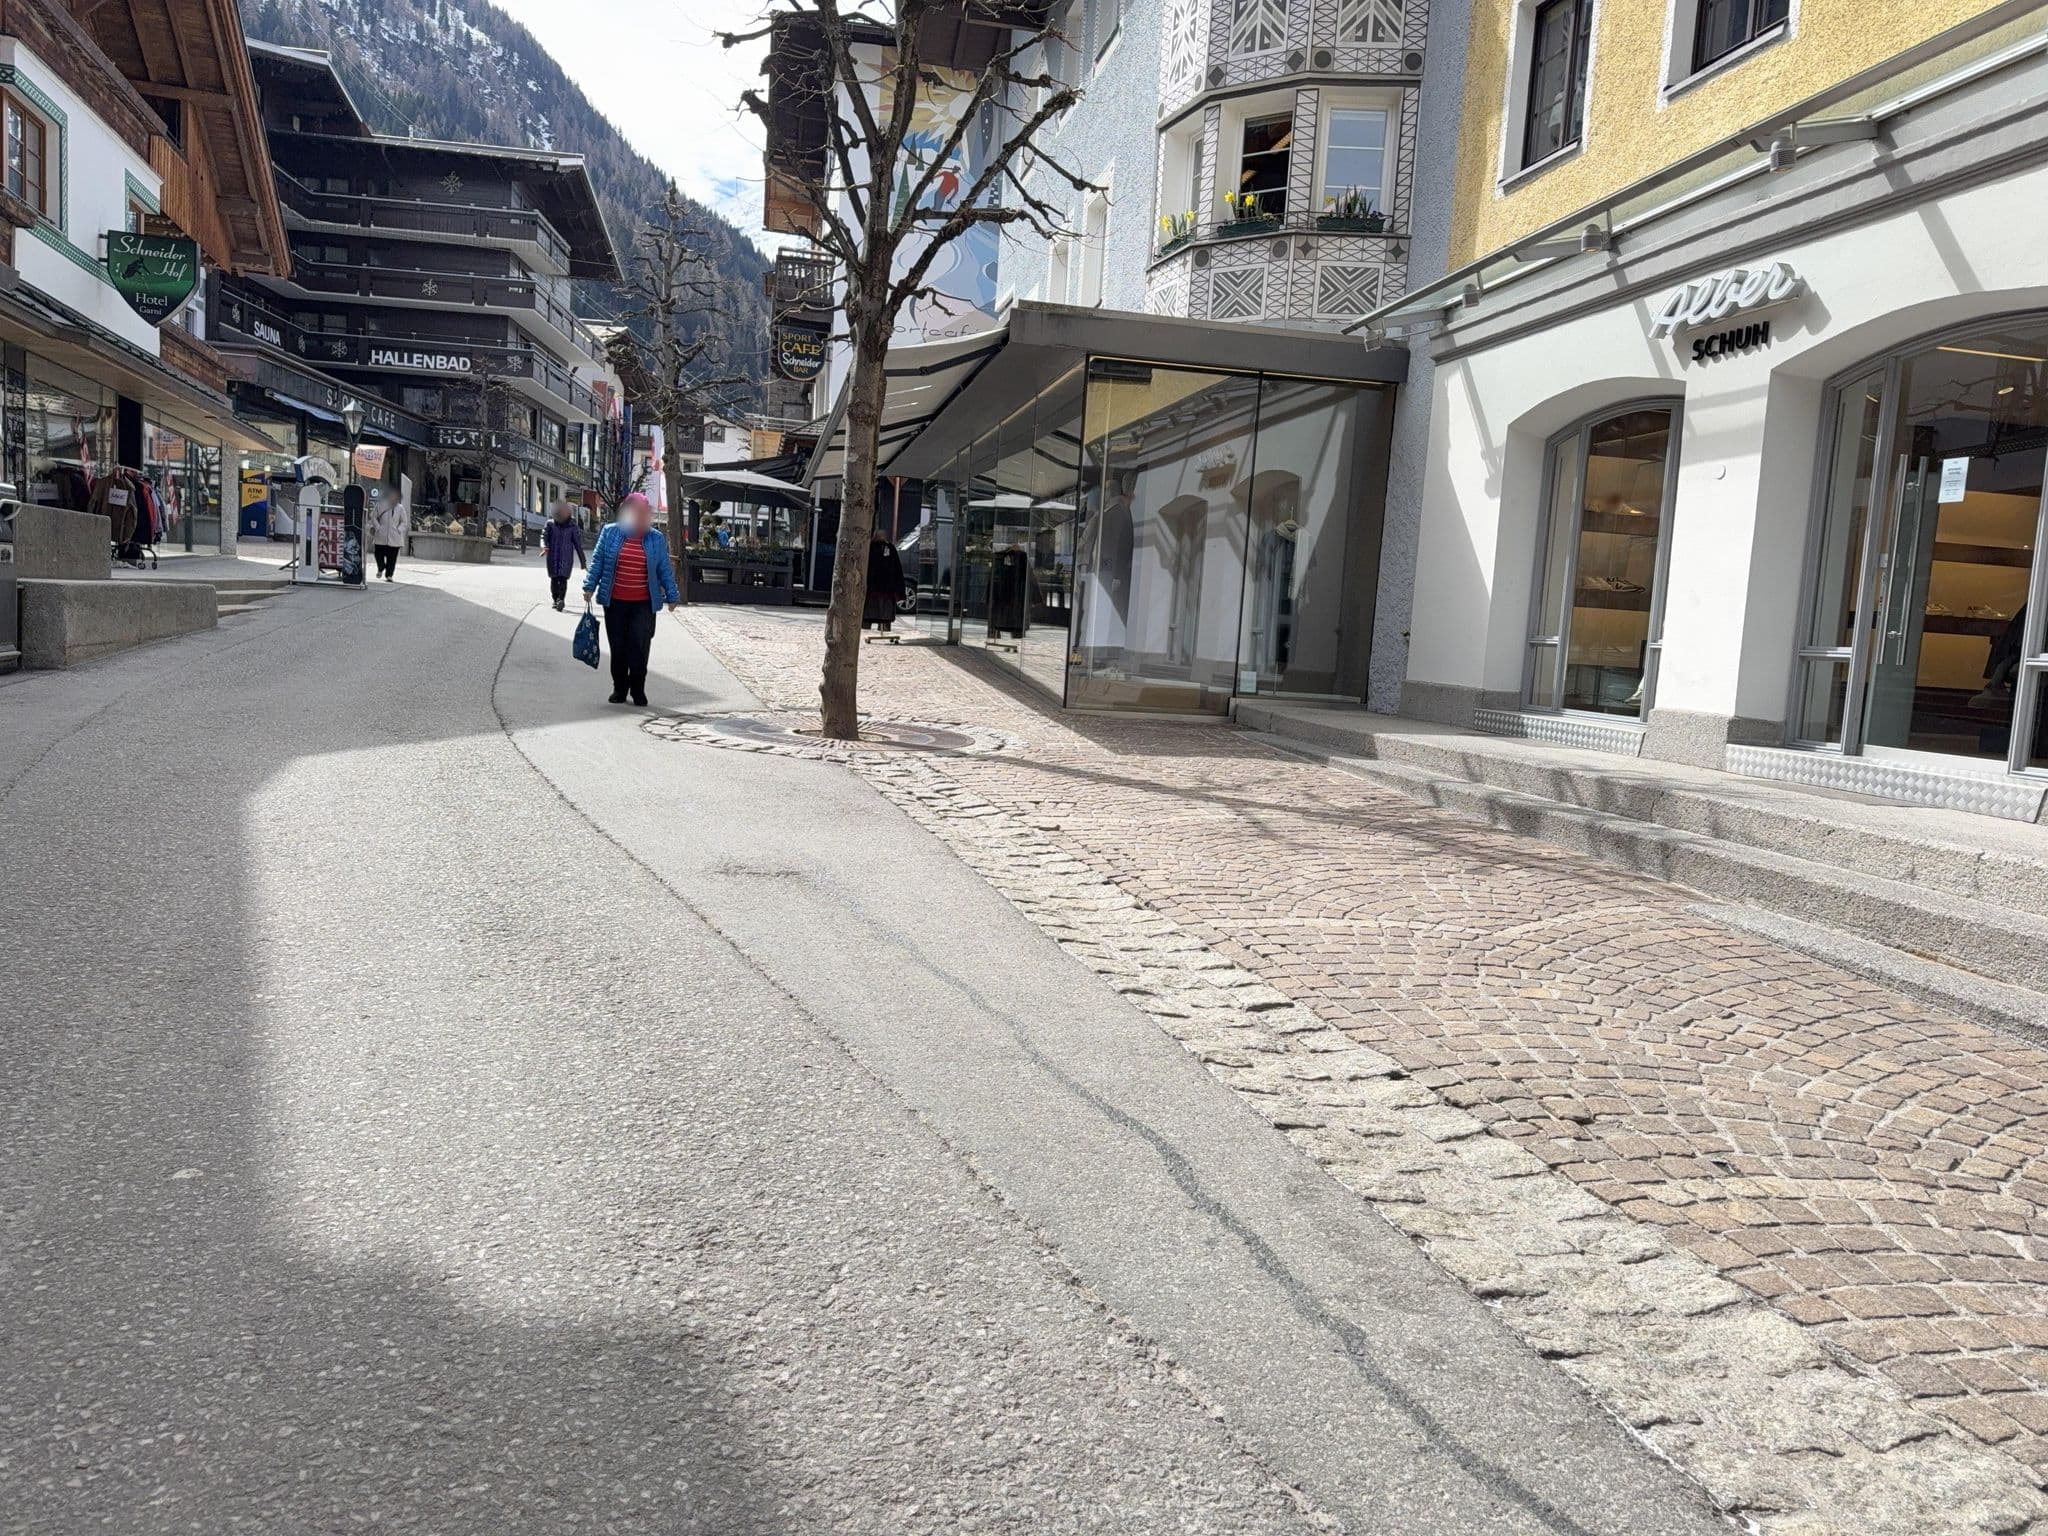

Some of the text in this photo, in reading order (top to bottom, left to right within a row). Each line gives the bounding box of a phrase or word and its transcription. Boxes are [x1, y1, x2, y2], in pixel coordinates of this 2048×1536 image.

[113, 235, 186, 261] Schneider
[153, 261, 188, 281] Hof
[135, 292, 168, 307] Hotel
[1650, 261, 1796, 340] Alber
[139, 305, 162, 315] Garni
[253, 320, 281, 347] SAUNA
[782, 332, 811, 342] SPORT
[1692, 321, 1770, 361] SCHUH
[781, 341, 822, 356] CAFE
[370, 349, 471, 371] HALLENBAD
[782, 352, 821, 369] Schneider
[793, 366, 808, 374] BAR
[371, 406, 395, 429] CAFE
[319, 518, 345, 530] ALE
[319, 530, 345, 541] ALE
[319, 542, 345, 554] ALE
[319, 553, 344, 566] ALE
